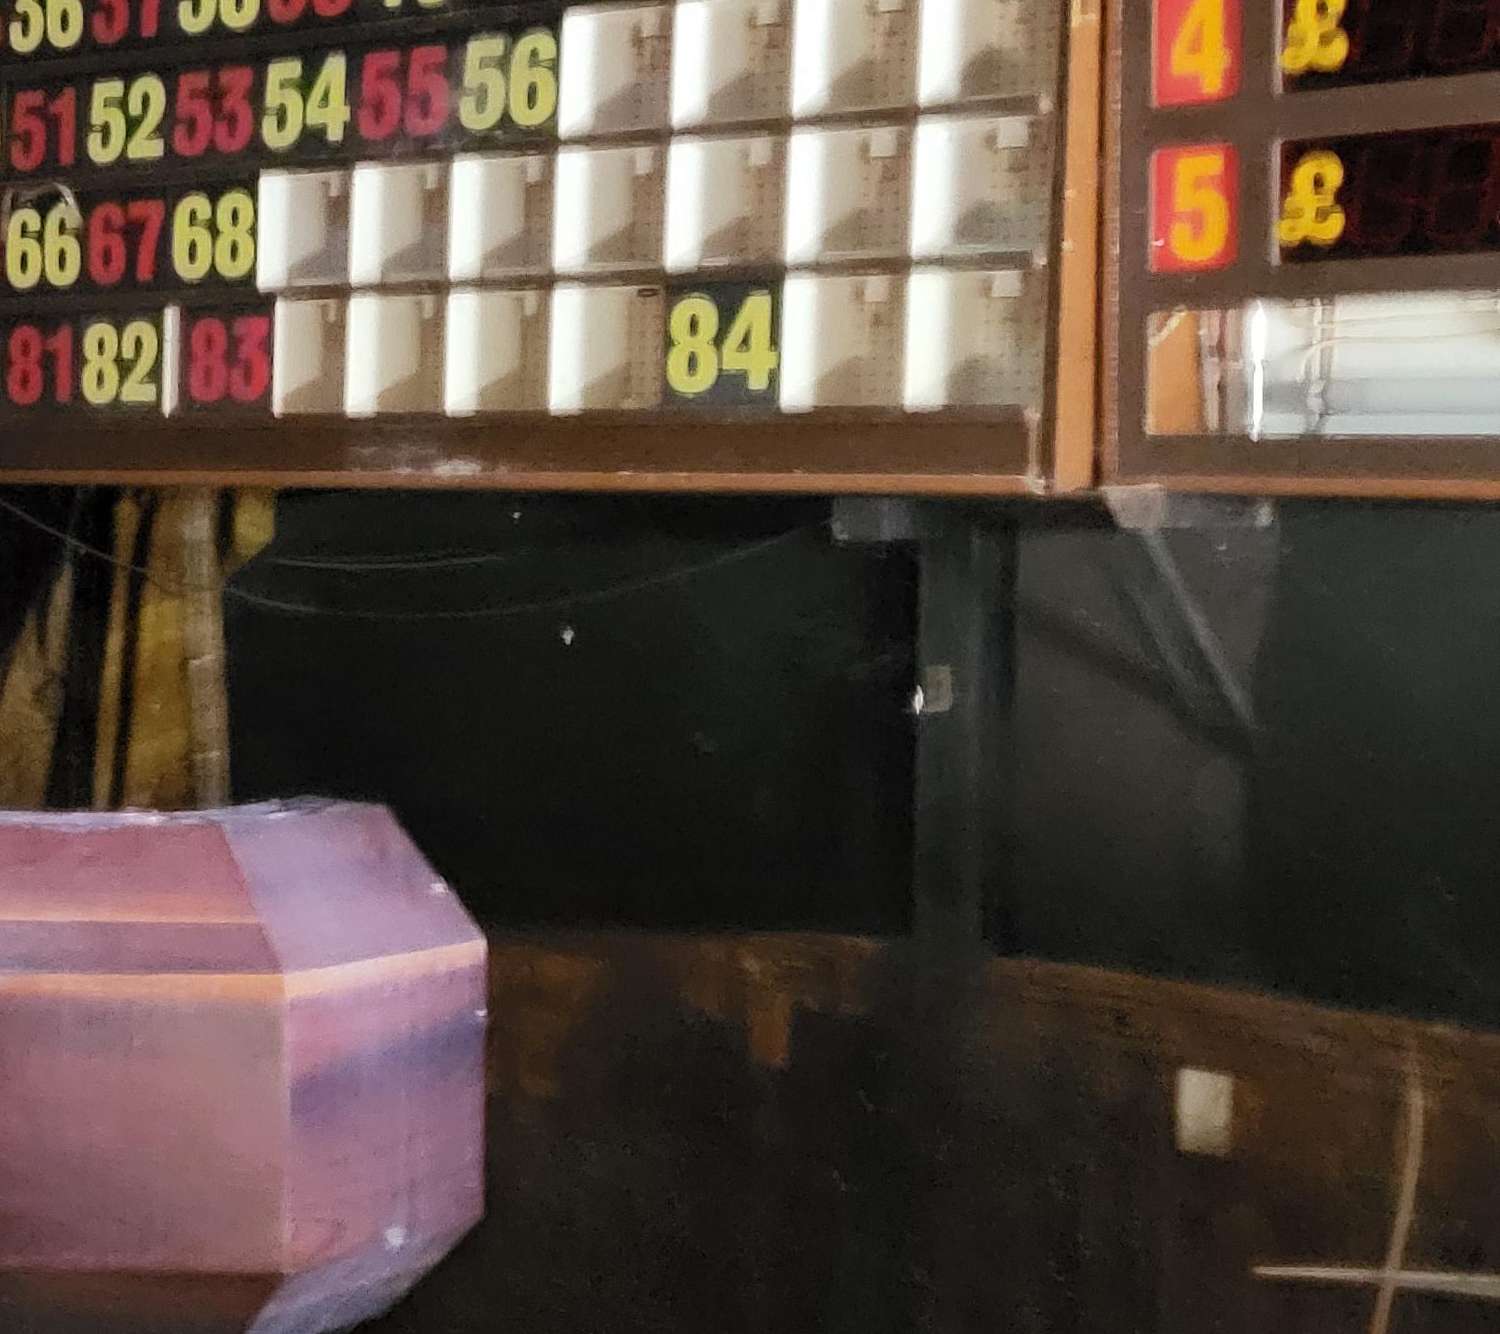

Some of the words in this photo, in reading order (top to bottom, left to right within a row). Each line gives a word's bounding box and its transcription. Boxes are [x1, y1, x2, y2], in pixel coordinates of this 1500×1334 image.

[10, 88, 76, 170] 51
[88, 73, 164, 163] 52
[174, 67, 254, 155] 53
[262, 52, 349, 150] 54
[359, 46, 449, 140] 55
[459, 29, 557, 129] 56
[6, 207, 81, 287] 66
[88, 199, 164, 284] 67
[173, 191, 255, 280] 68
[1172, 154, 1231, 261] 5
[1280, 149, 1345, 246] £
[8, 324, 71, 403] 81
[82, 320, 157, 403] 82
[187, 316, 270, 403] 83
[667, 290, 779, 393] 84
